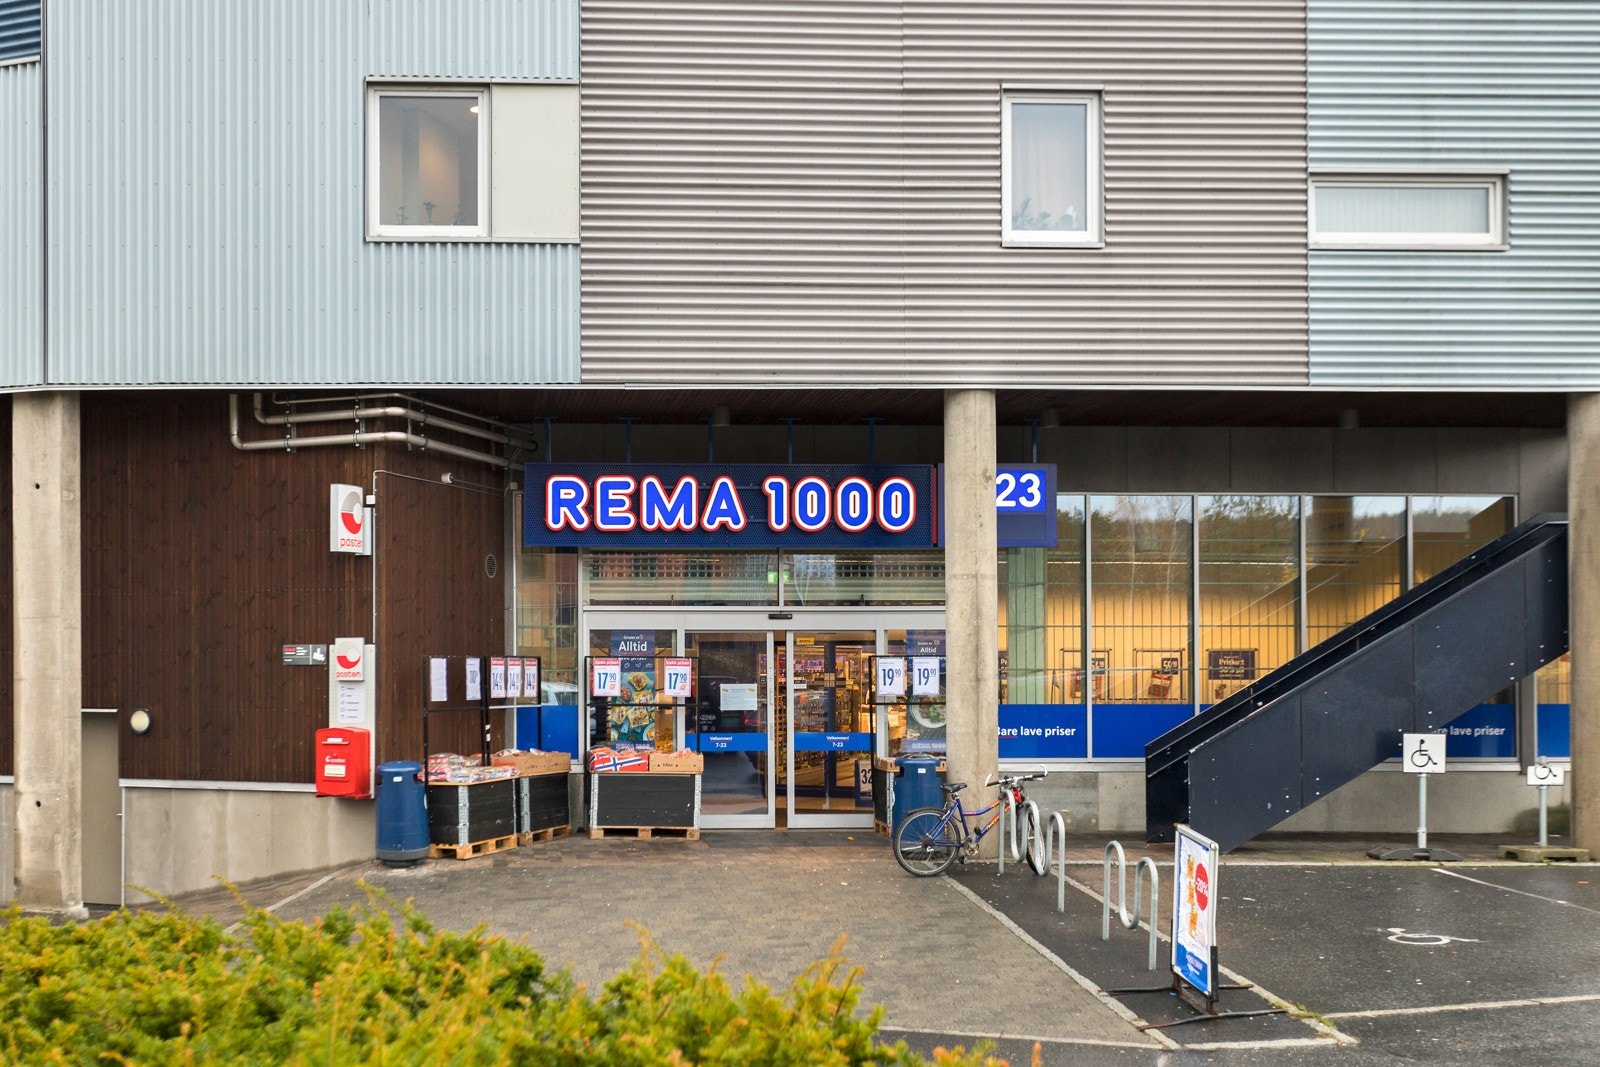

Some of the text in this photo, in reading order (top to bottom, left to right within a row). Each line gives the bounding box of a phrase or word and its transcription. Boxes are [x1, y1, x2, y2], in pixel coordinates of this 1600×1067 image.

[545, 474, 916, 532] REMA 1000
[618, 641, 647, 652] Alltid
[336, 671, 362, 680] posten
[597, 672, 616, 689] 17 90
[668, 672, 688, 690] 17 90
[882, 668, 895, 686] 19
[917, 668, 930, 686] 19
[1020, 726, 1042, 736] lave
[1044, 726, 1076, 738] priser
[1450, 726, 1472, 735] lave
[1474, 725, 1506, 737] priser
